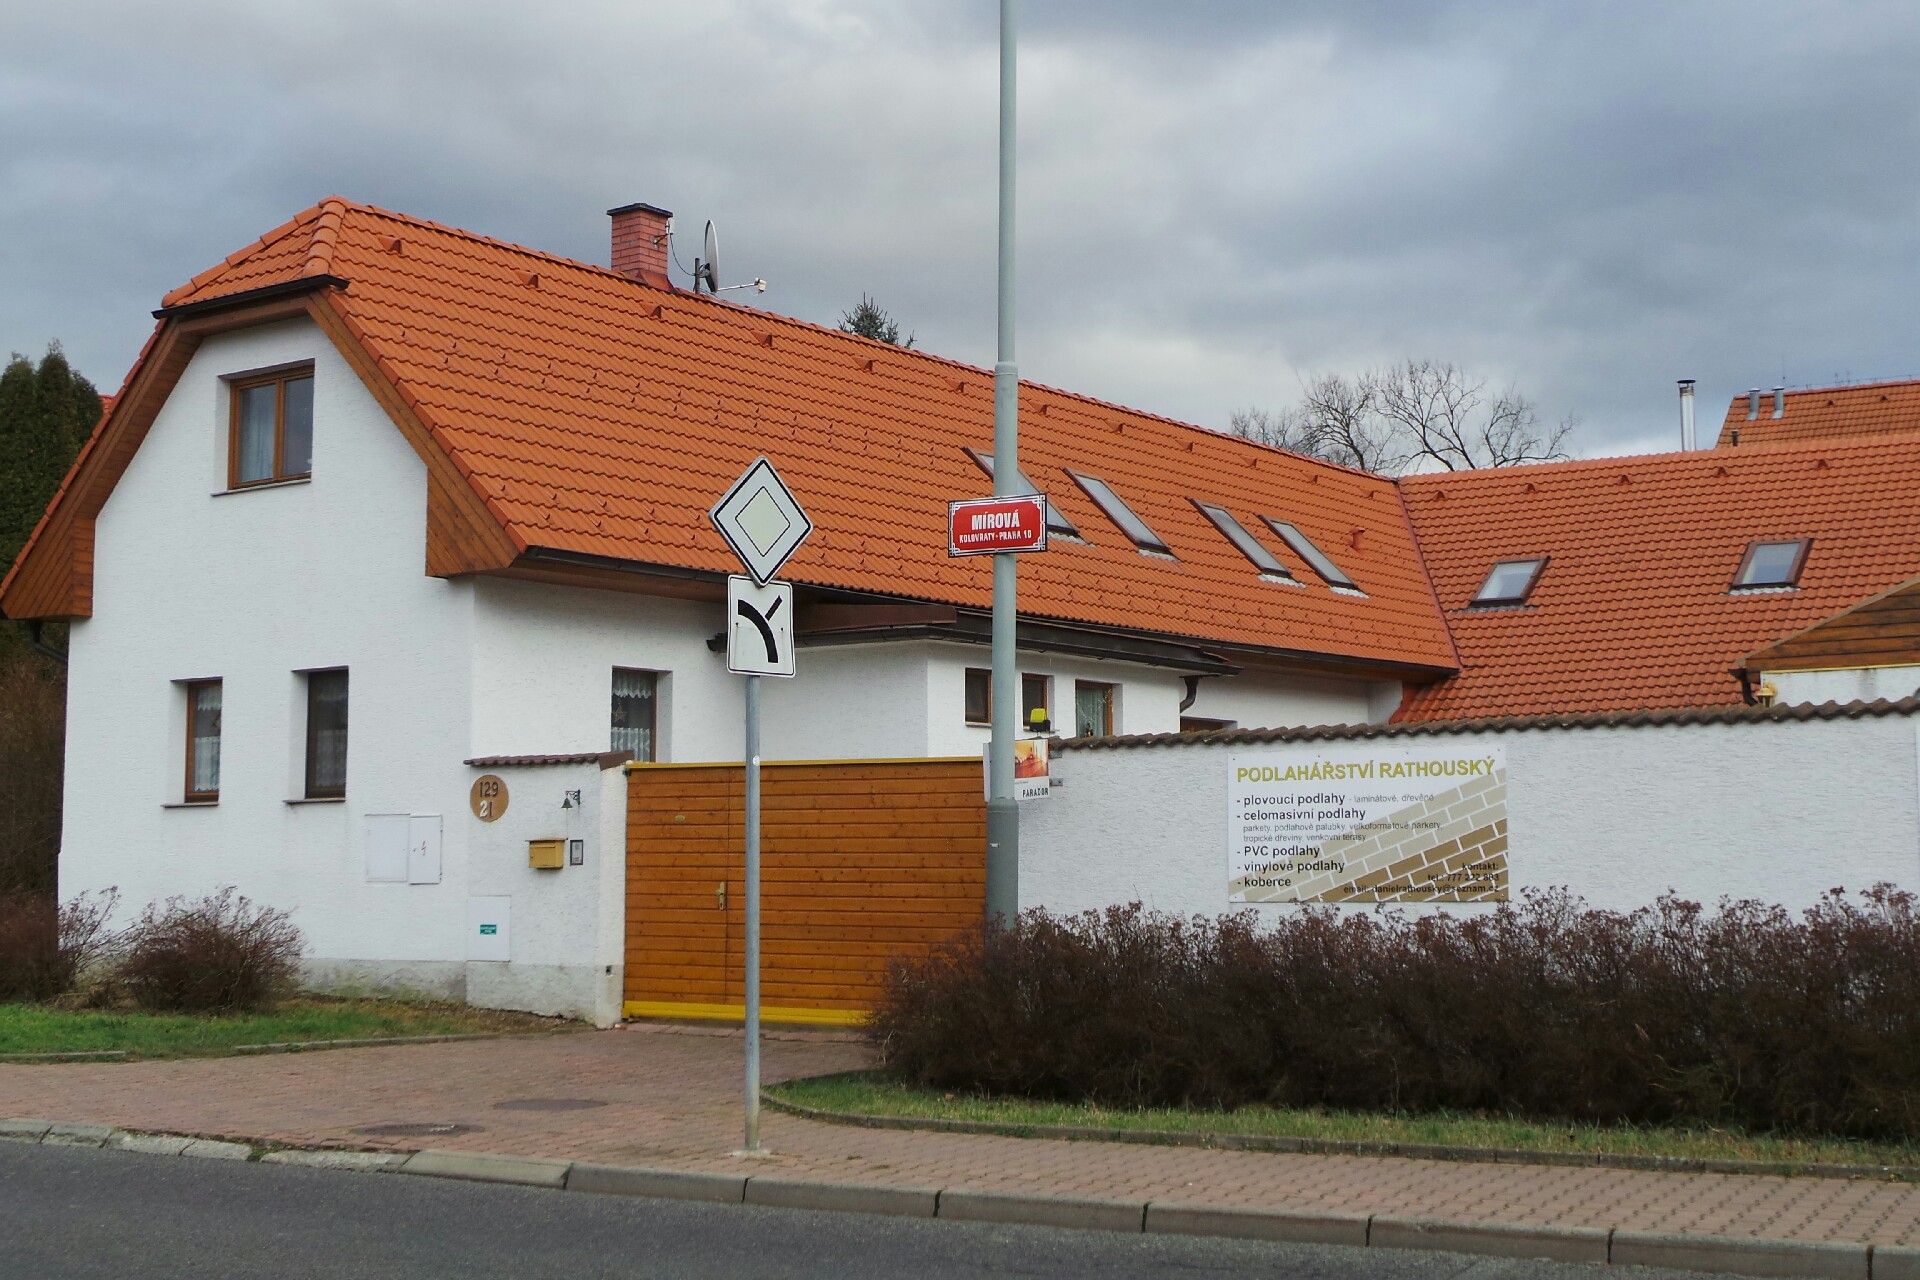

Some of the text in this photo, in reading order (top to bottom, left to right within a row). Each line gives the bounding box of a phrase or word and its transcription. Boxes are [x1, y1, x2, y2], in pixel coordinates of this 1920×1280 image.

[971, 509, 1020, 531] MÍROVÁ
[1024, 529, 1032, 538] 10
[1237, 755, 1496, 783] PODLAHÁŘSTVÍ RATHOUSKÝ
[480, 781, 499, 798] 129
[1244, 794, 1294, 807] plovoucí
[1298, 793, 1346, 806] podlahy
[480, 800, 493, 818] 21
[1244, 808, 1314, 820] celomasivní
[1318, 808, 1366, 821] podlahy
[1274, 823, 1314, 832] podlahové
[1244, 834, 1272, 843] tropické
[1342, 833, 1366, 842] terasy
[1244, 846, 1268, 856] PVC
[1272, 845, 1320, 858] podlahy
[1244, 861, 1294, 874] vinylové
[1297, 860, 1345, 874] podlahy
[1462, 862, 1499, 871] kontakt:
[1244, 876, 1292, 887] koberce
[1447, 873, 1462, 882] 777
